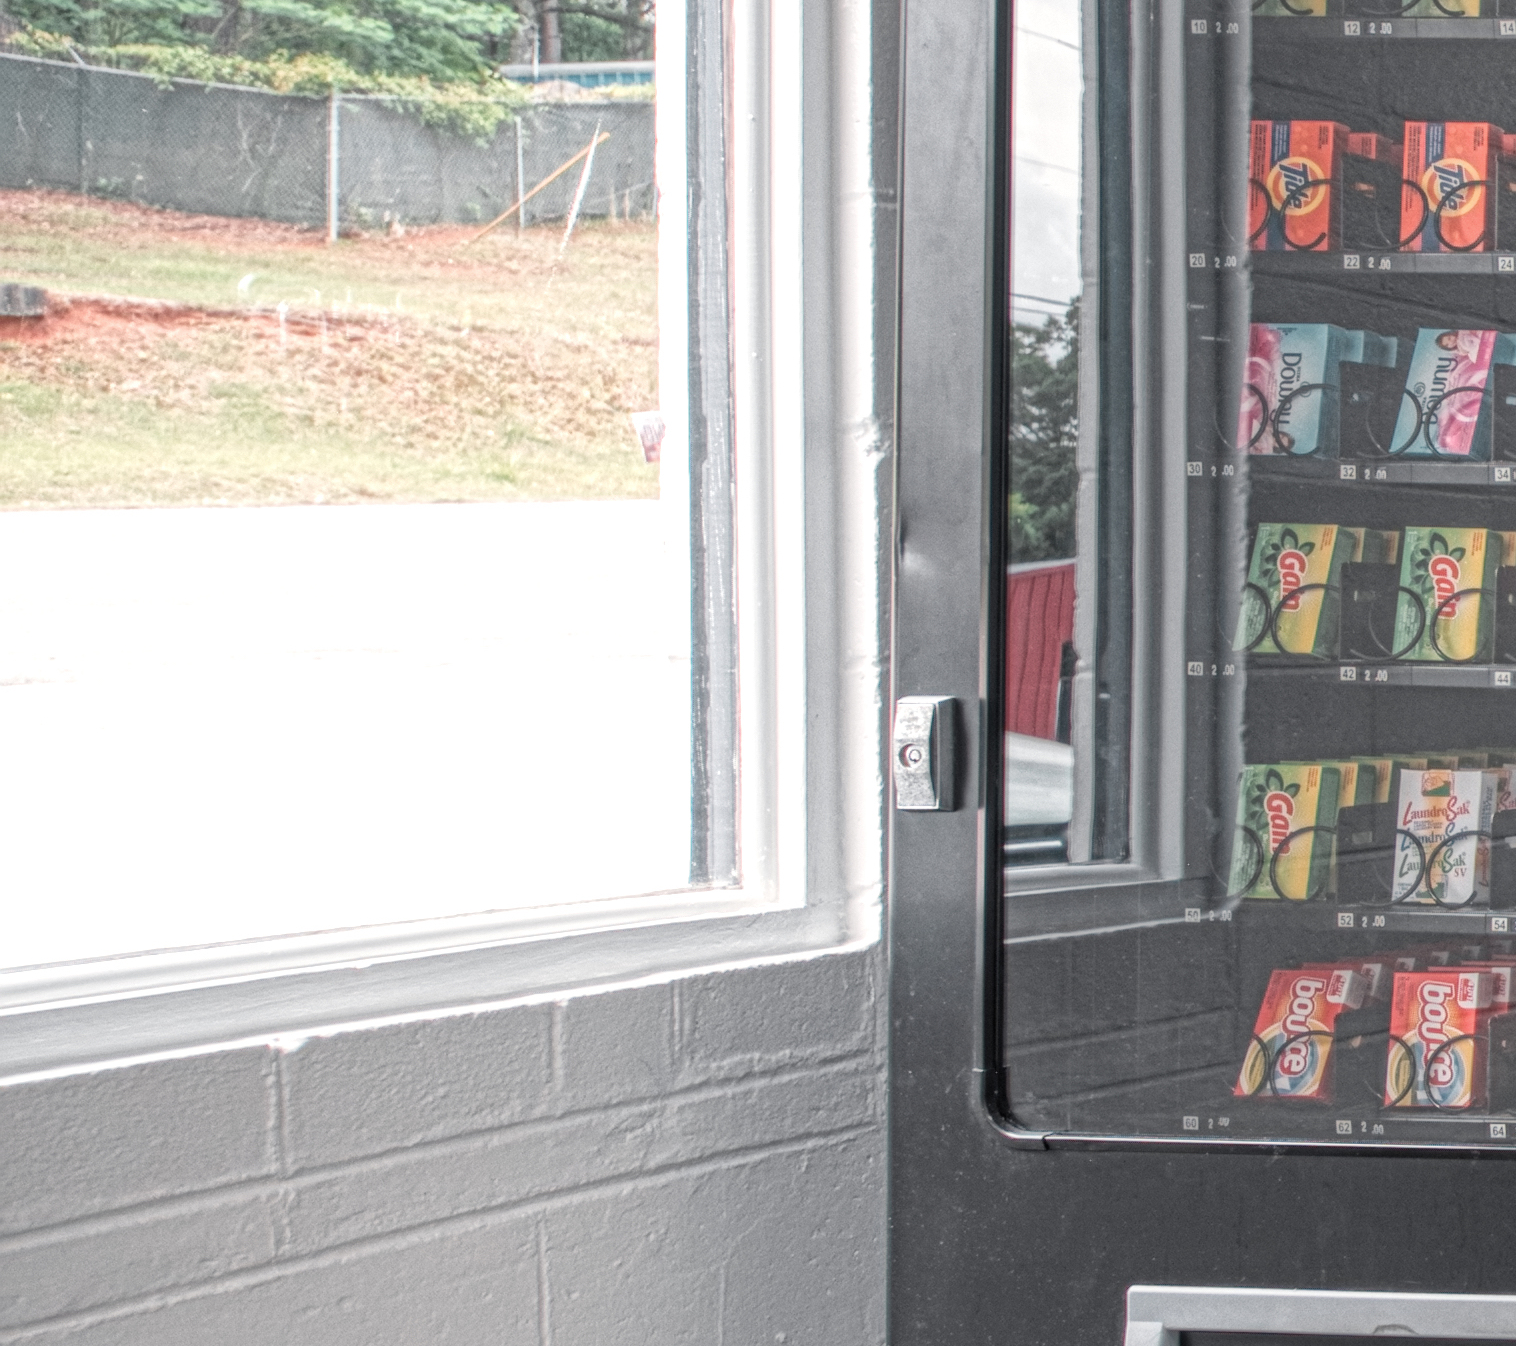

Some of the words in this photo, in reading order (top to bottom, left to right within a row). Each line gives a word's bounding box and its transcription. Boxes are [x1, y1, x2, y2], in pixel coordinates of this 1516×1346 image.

[1194, 22, 1205, 33] 10
[1346, 23, 1358, 34] 12
[1278, 160, 1311, 210] Tide
[1431, 161, 1466, 211] Tide
[1346, 257, 1358, 267] 22
[1497, 470, 1509, 480] 34
[1428, 555, 1461, 619] Gain
[1342, 669, 1354, 679] 42
[1264, 791, 1295, 857] Gain
[1494, 919, 1506, 930] 54
[1338, 1122, 1350, 1132] 62
